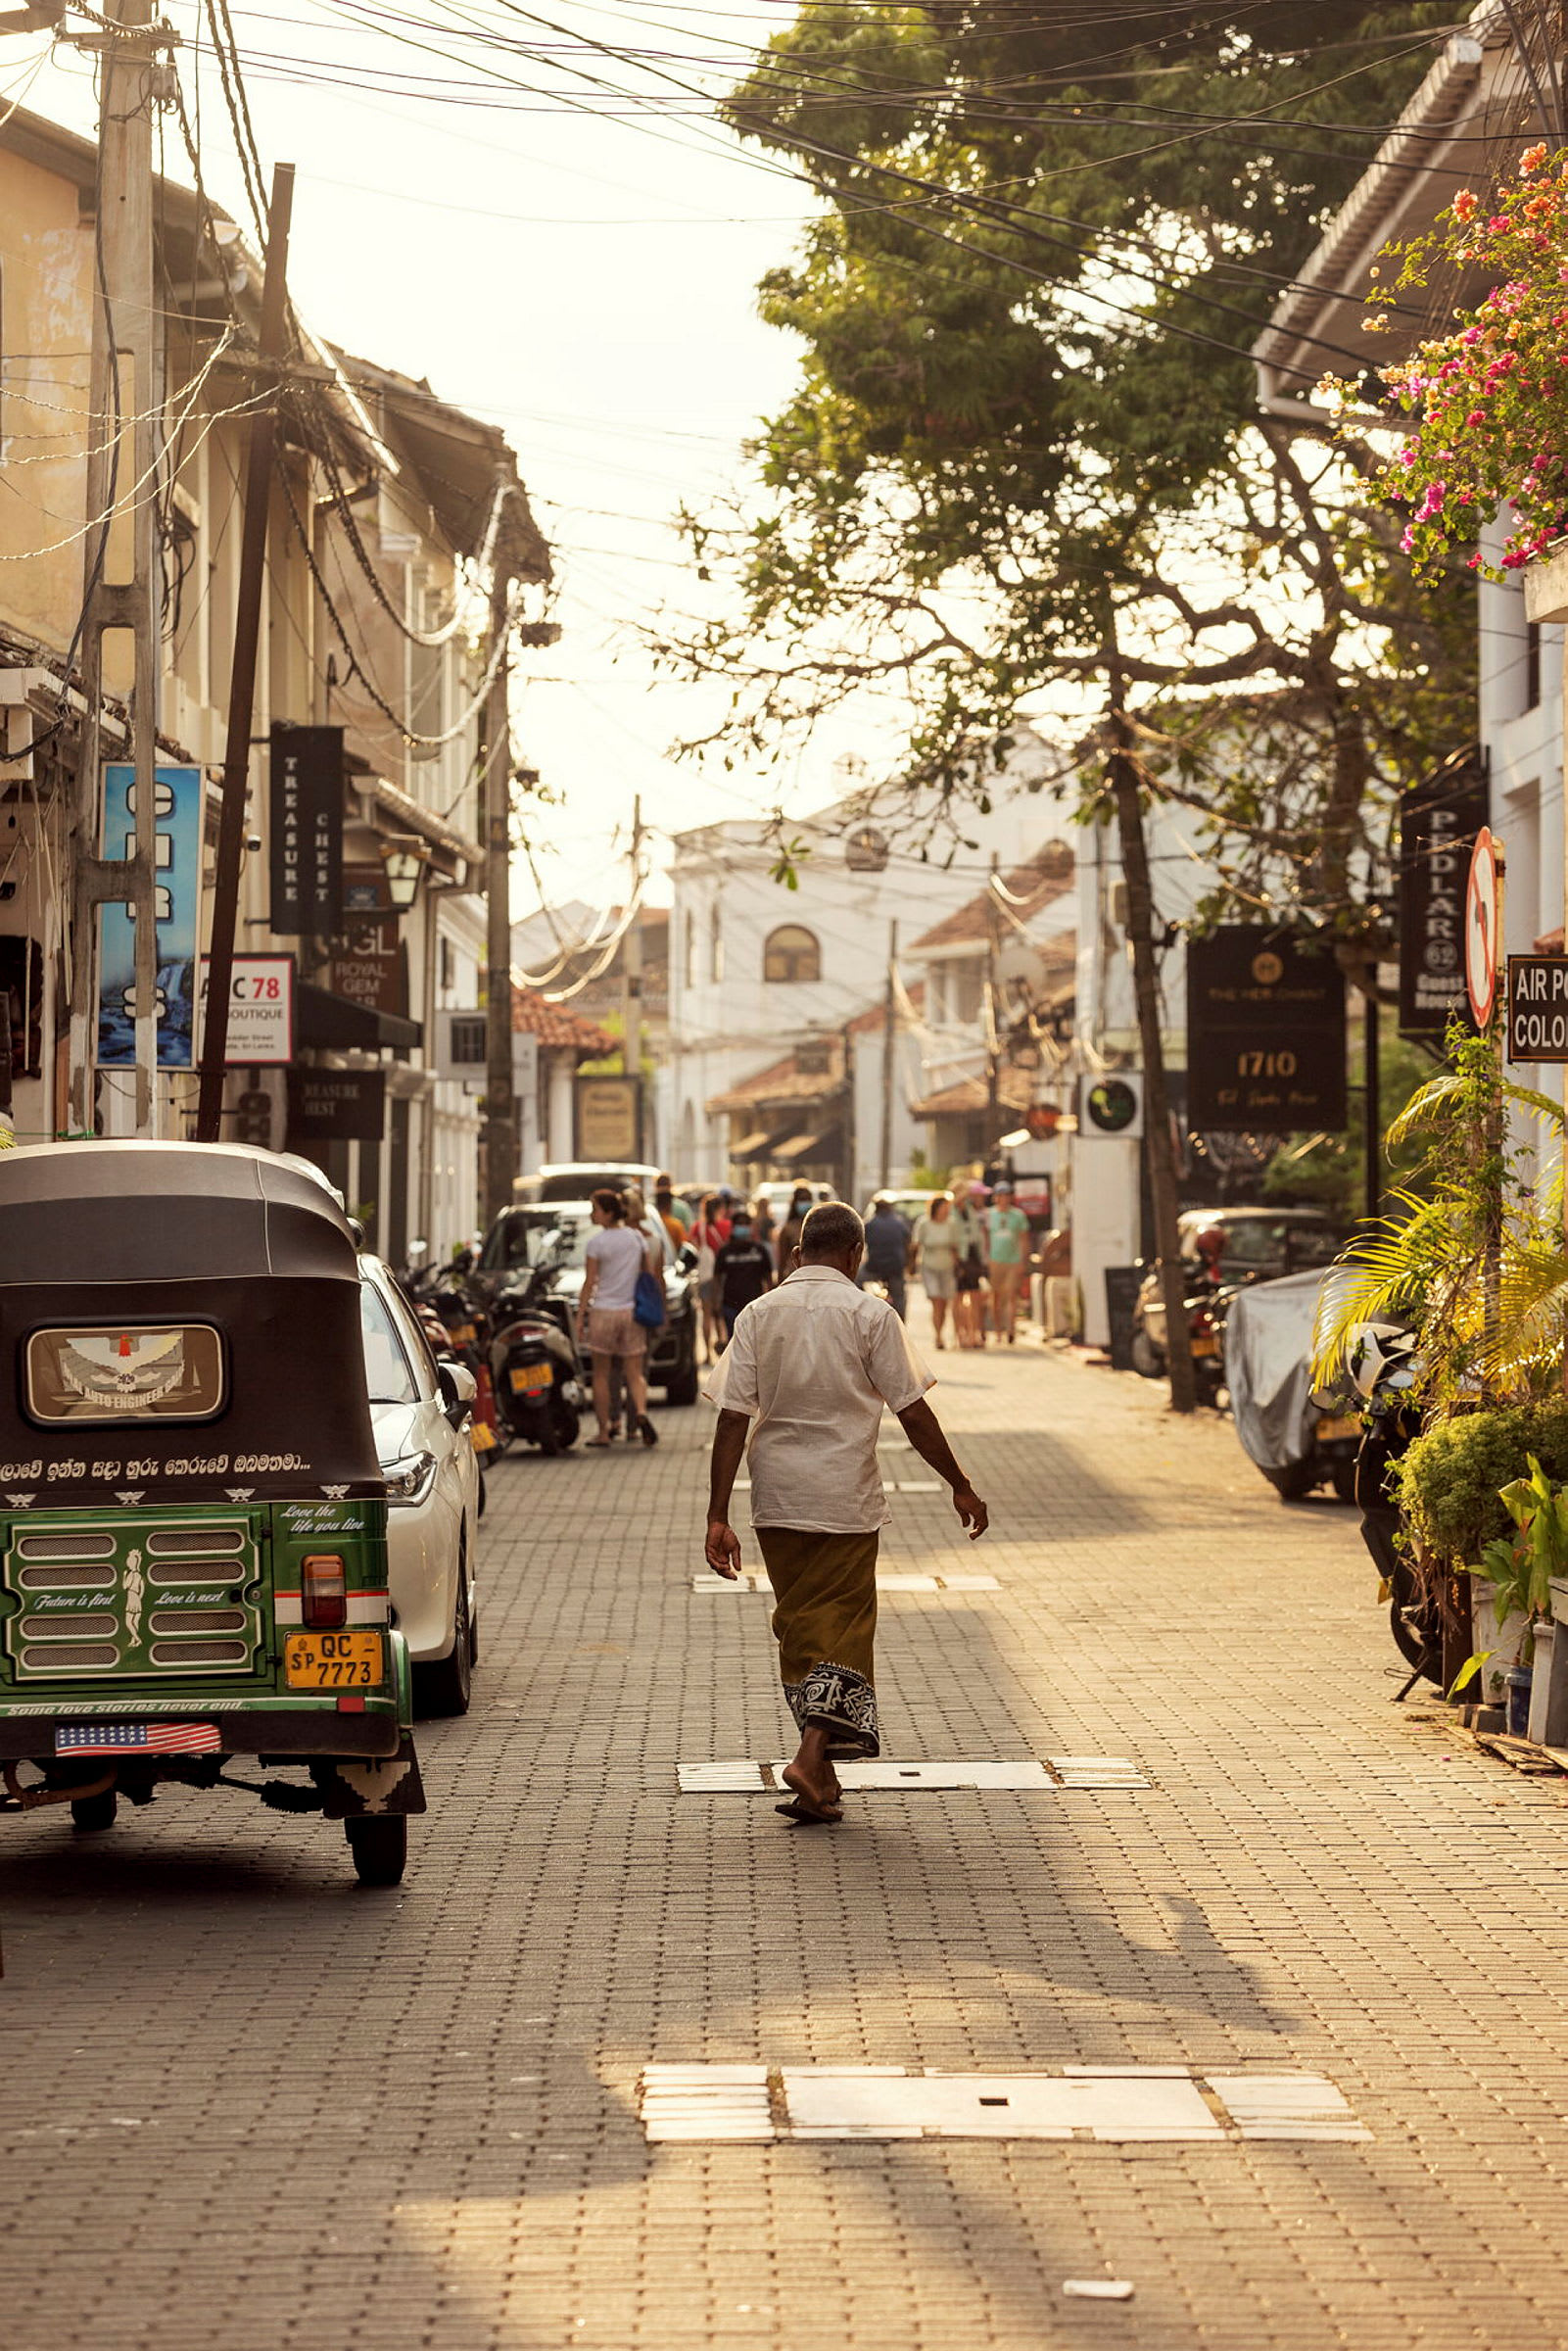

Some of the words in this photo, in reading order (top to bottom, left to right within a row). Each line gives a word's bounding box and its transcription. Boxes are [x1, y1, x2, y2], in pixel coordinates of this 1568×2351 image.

[285, 757, 298, 901] TREASURE
[315, 813, 329, 902] CHEST
[1426, 811, 1458, 938] PEDLAR
[336, 961, 388, 979] ROYAL
[253, 976, 281, 999] 78
[1515, 967, 1548, 1000] AIR
[229, 1008, 283, 1021] OUTIQUE
[1514, 1014, 1568, 1048] COLO
[1238, 1051, 1297, 1077] 1710
[280, 1504, 313, 1518] Love
[314, 1504, 337, 1517] the
[290, 1519, 314, 1534] life
[313, 1522, 341, 1534] you
[341, 1516, 365, 1531] live
[34, 1594, 75, 1611] Future
[76, 1593, 87, 1607] is
[87, 1593, 118, 1608] first
[154, 1592, 184, 1606] Love
[185, 1591, 196, 1604] is
[197, 1590, 226, 1604] next
[321, 1635, 353, 1658] QC
[292, 1652, 314, 1671] SP
[317, 1660, 372, 1686] 7773
[8, 1704, 55, 1715] Some
[57, 1703, 96, 1714] love
[97, 1702, 158, 1713] stories
[158, 1702, 208, 1712] never
